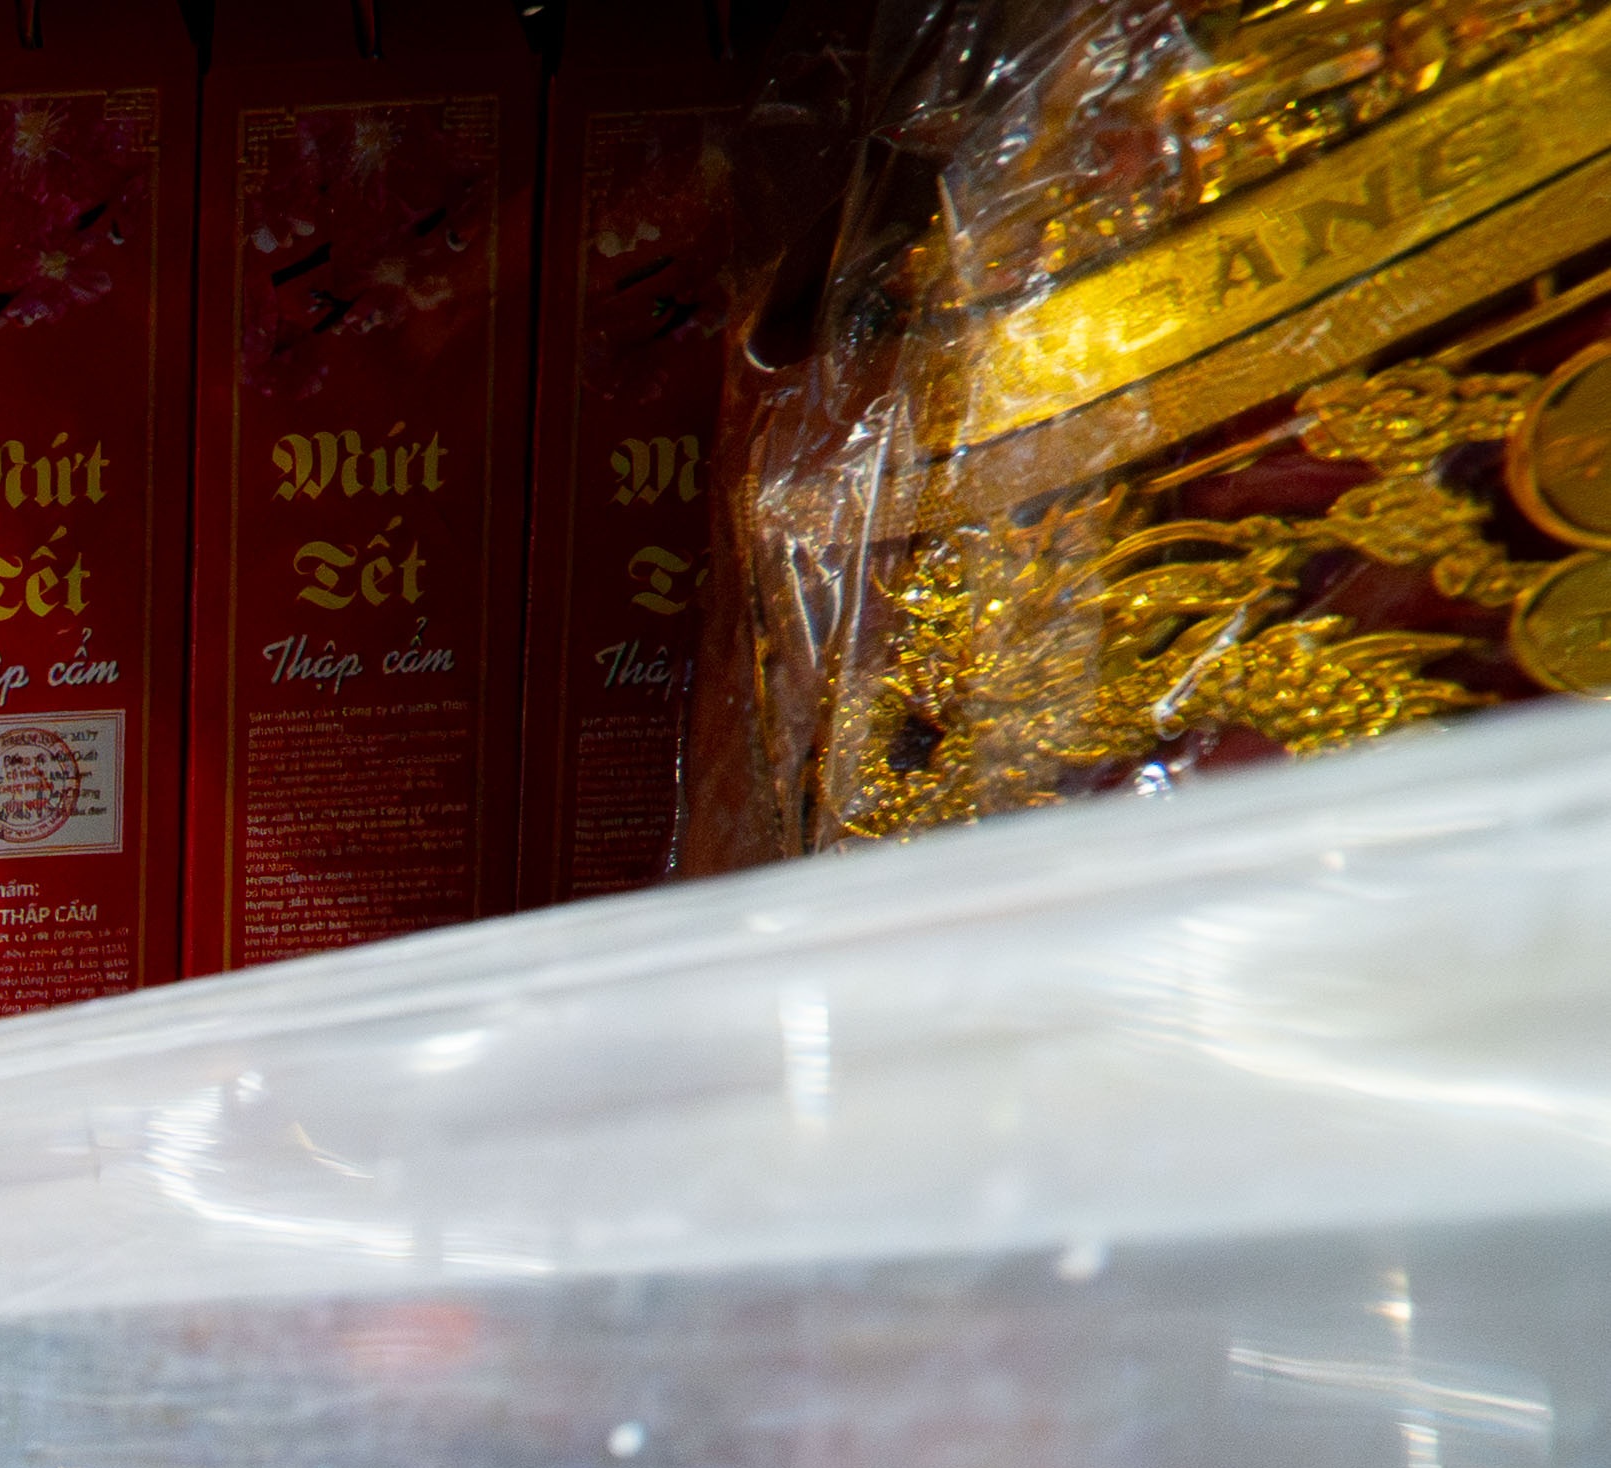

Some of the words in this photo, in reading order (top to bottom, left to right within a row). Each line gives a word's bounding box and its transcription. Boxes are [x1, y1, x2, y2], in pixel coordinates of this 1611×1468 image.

[272, 421, 448, 501] Mứt
[293, 515, 426, 610] Tết
[48, 627, 119, 687] cẩm
[263, 634, 364, 695] Thập
[382, 616, 455, 675] cẩm
[54, 898, 98, 923] CẨM
